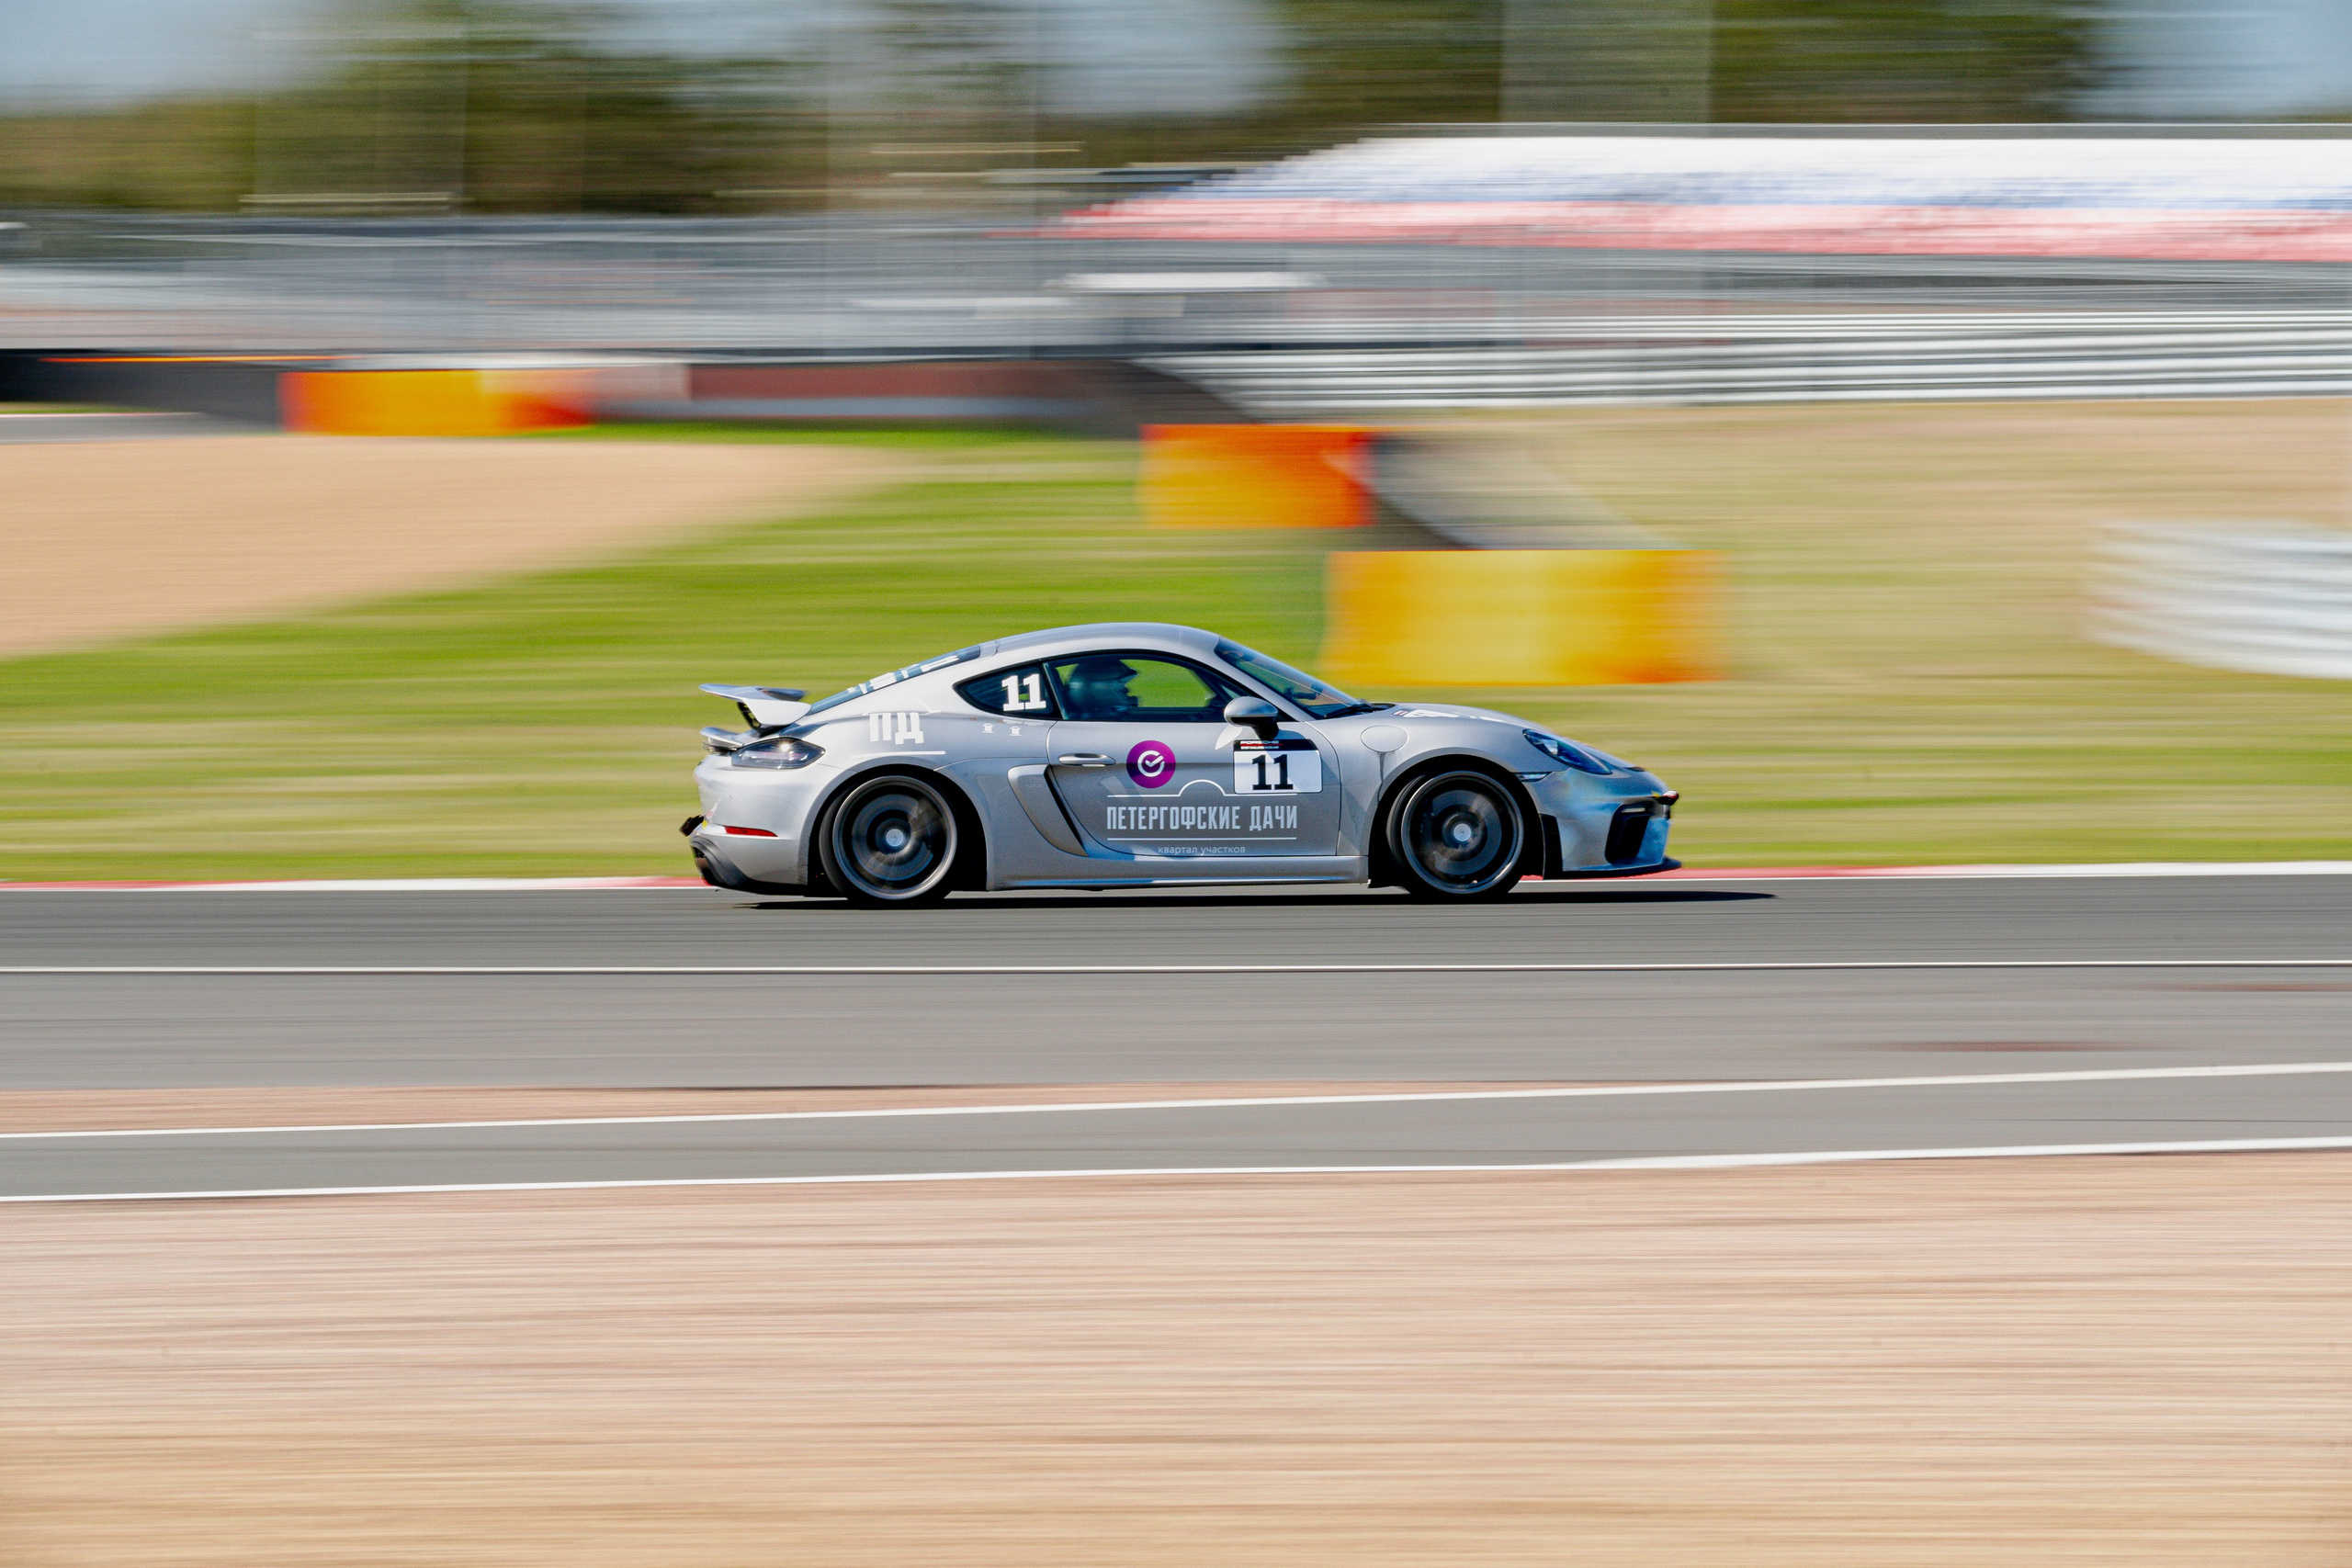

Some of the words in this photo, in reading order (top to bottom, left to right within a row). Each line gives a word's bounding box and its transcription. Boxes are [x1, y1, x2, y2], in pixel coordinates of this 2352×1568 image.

[1001, 673, 1047, 712] 11
[869, 712, 924, 745] ПД
[1251, 753, 1294, 791] 11
[1107, 806, 1240, 830] ПЕТЕРГОФСКИЕ
[1250, 805, 1297, 831] ДАЧИ
[1158, 846, 1198, 856] квартал
[1200, 846, 1246, 856] участков
